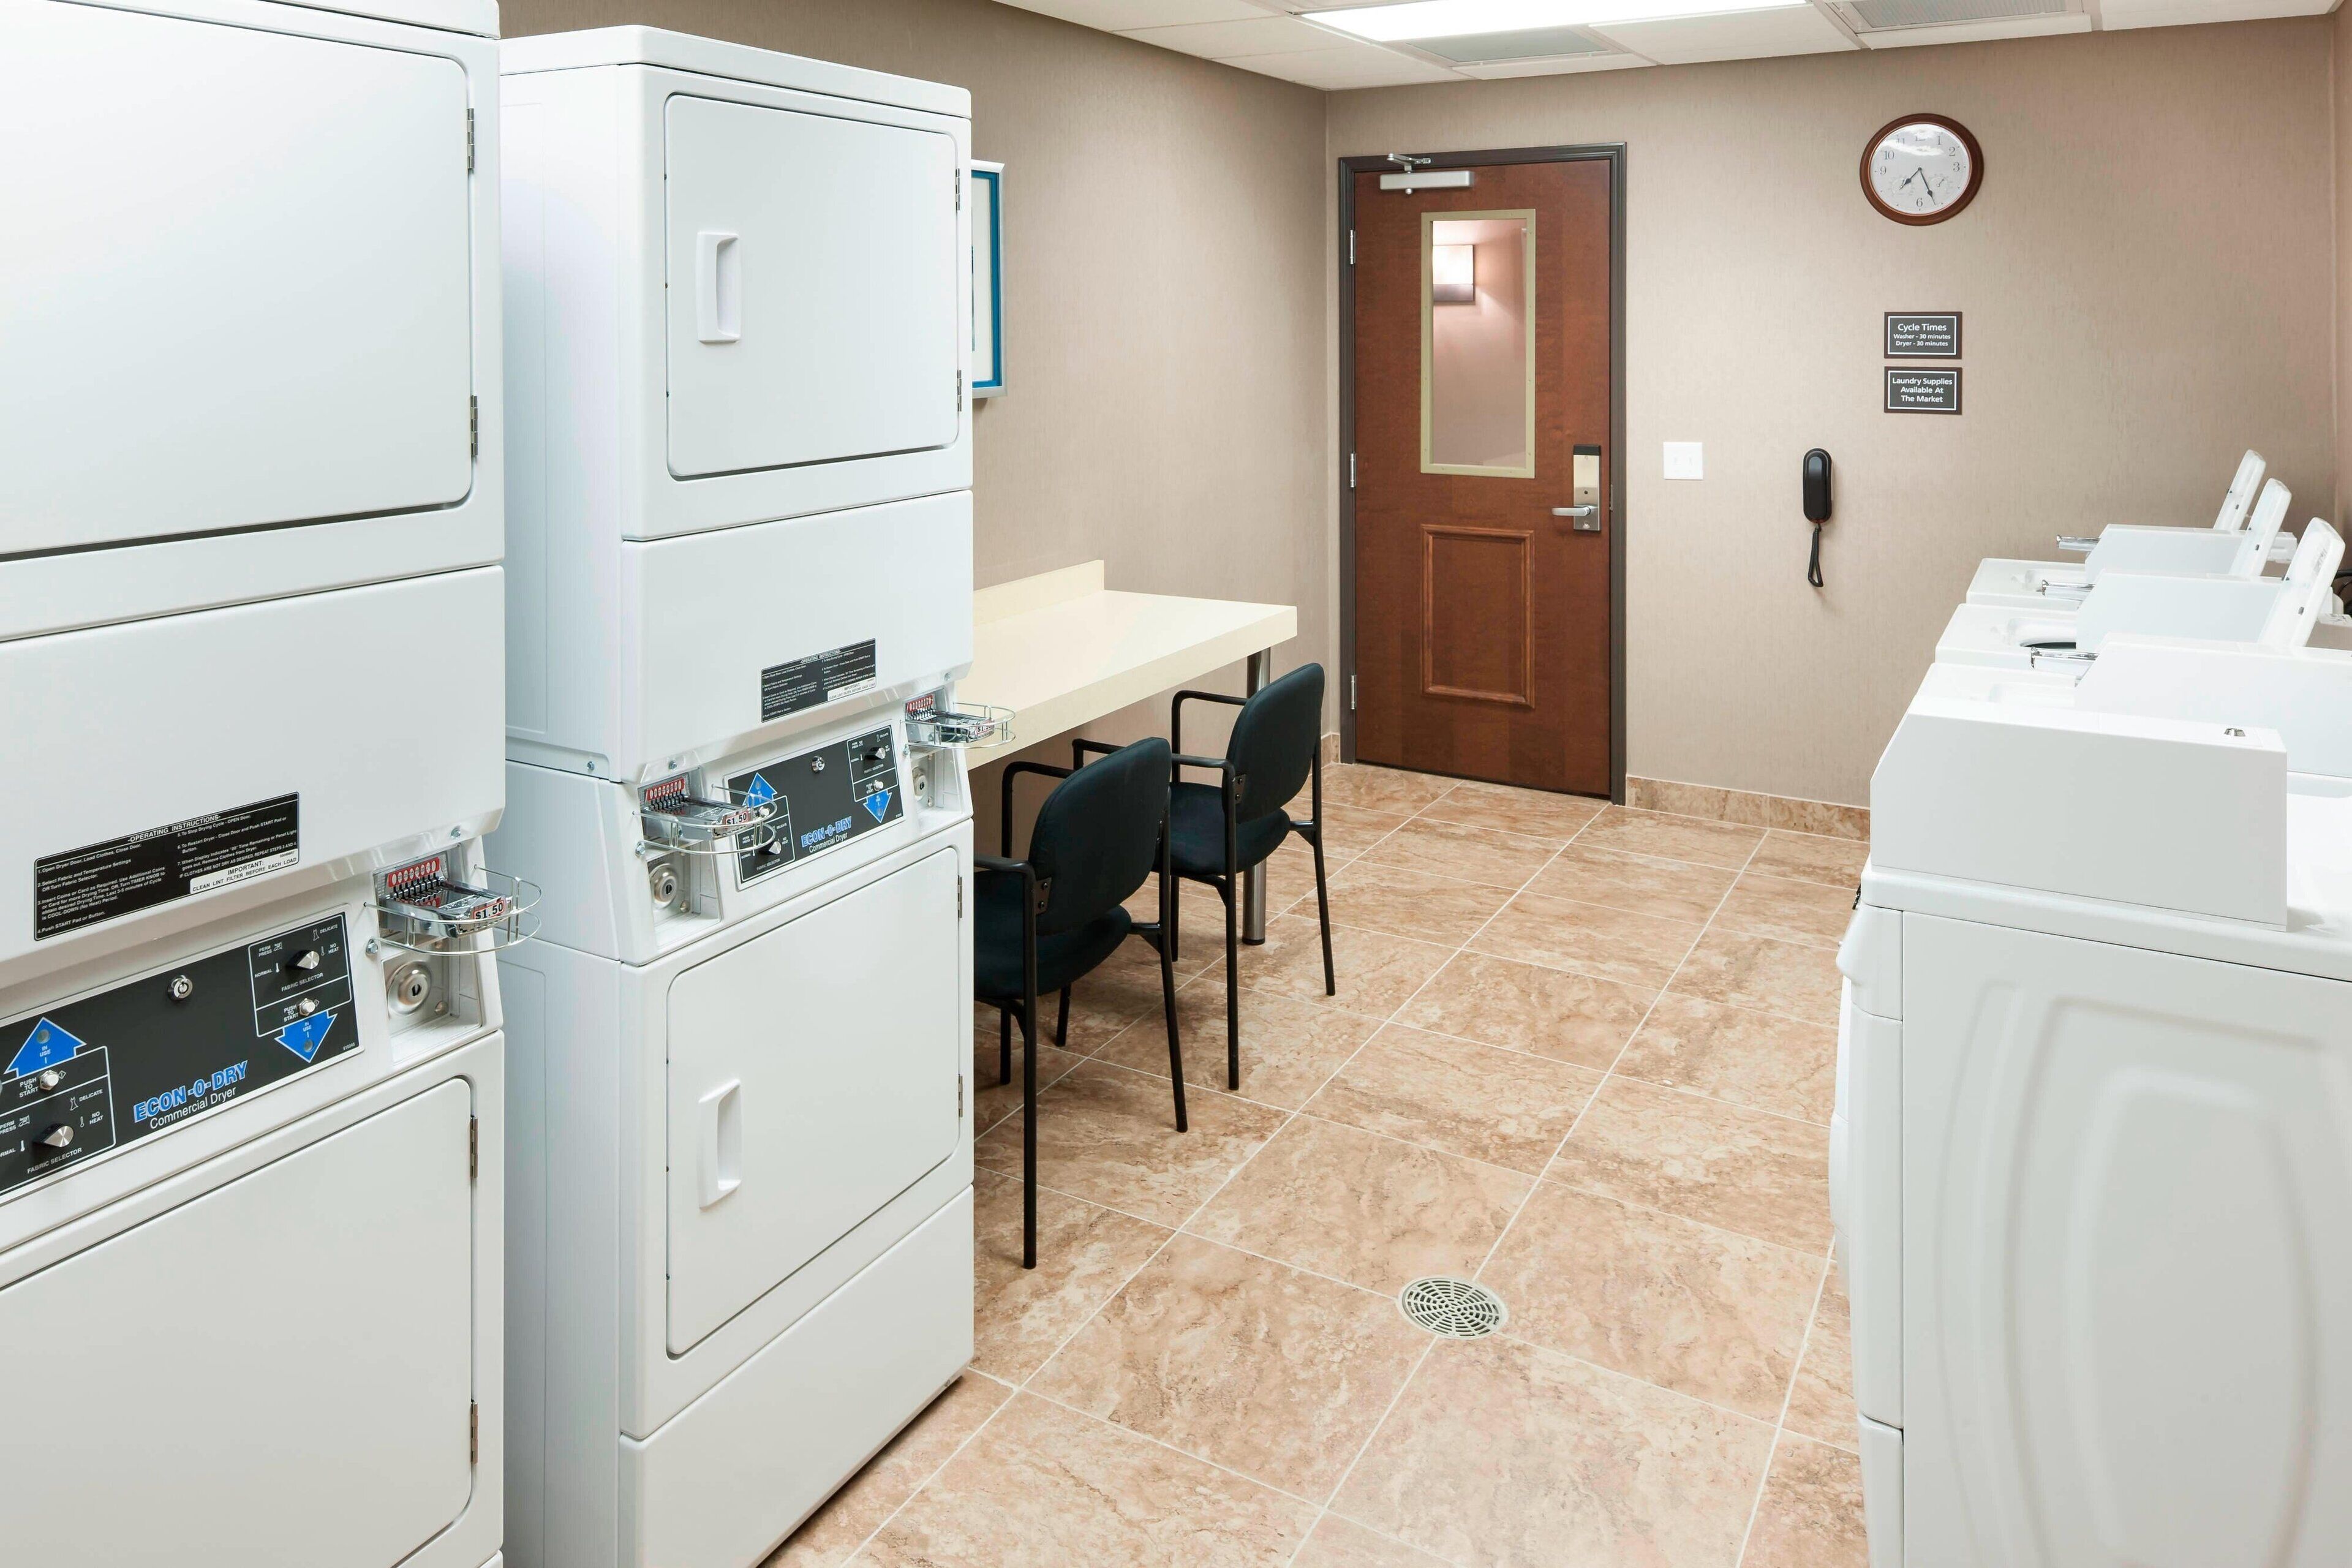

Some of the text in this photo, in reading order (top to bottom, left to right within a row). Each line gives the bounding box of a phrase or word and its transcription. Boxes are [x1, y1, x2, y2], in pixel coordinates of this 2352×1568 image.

[1937, 136, 1941, 145] 1
[1884, 150, 1894, 160] 10
[1948, 146, 1956, 157] 2
[1880, 166, 1887, 175] 9
[1953, 162, 1960, 172] 3
[1916, 198, 1923, 207] 6
[1898, 323, 1920, 332] Cycle
[1892, 377, 1953, 386] Laundry Supplies
[726, 813, 747, 824] $1.50
[809, 832, 848, 853] Commercial Dryer
[227, 861, 264, 875] IMPORTANT:
[246, 867, 265, 875] BEFORE
[475, 902, 503, 919] $1.50
[320, 924, 338, 934] DELICATE
[281, 973, 323, 992] FABRIC SELECTOR
[284, 1012, 299, 1022] START
[20, 1077, 37, 1087] PUSH
[19, 1086, 39, 1098] START
[79, 1088, 104, 1102] DELICATE
[150, 1087, 236, 1129] Commercial Dryer
[89, 1115, 104, 1125] HEAT
[27, 1147, 82, 1174] FABRIC SELECTOR
